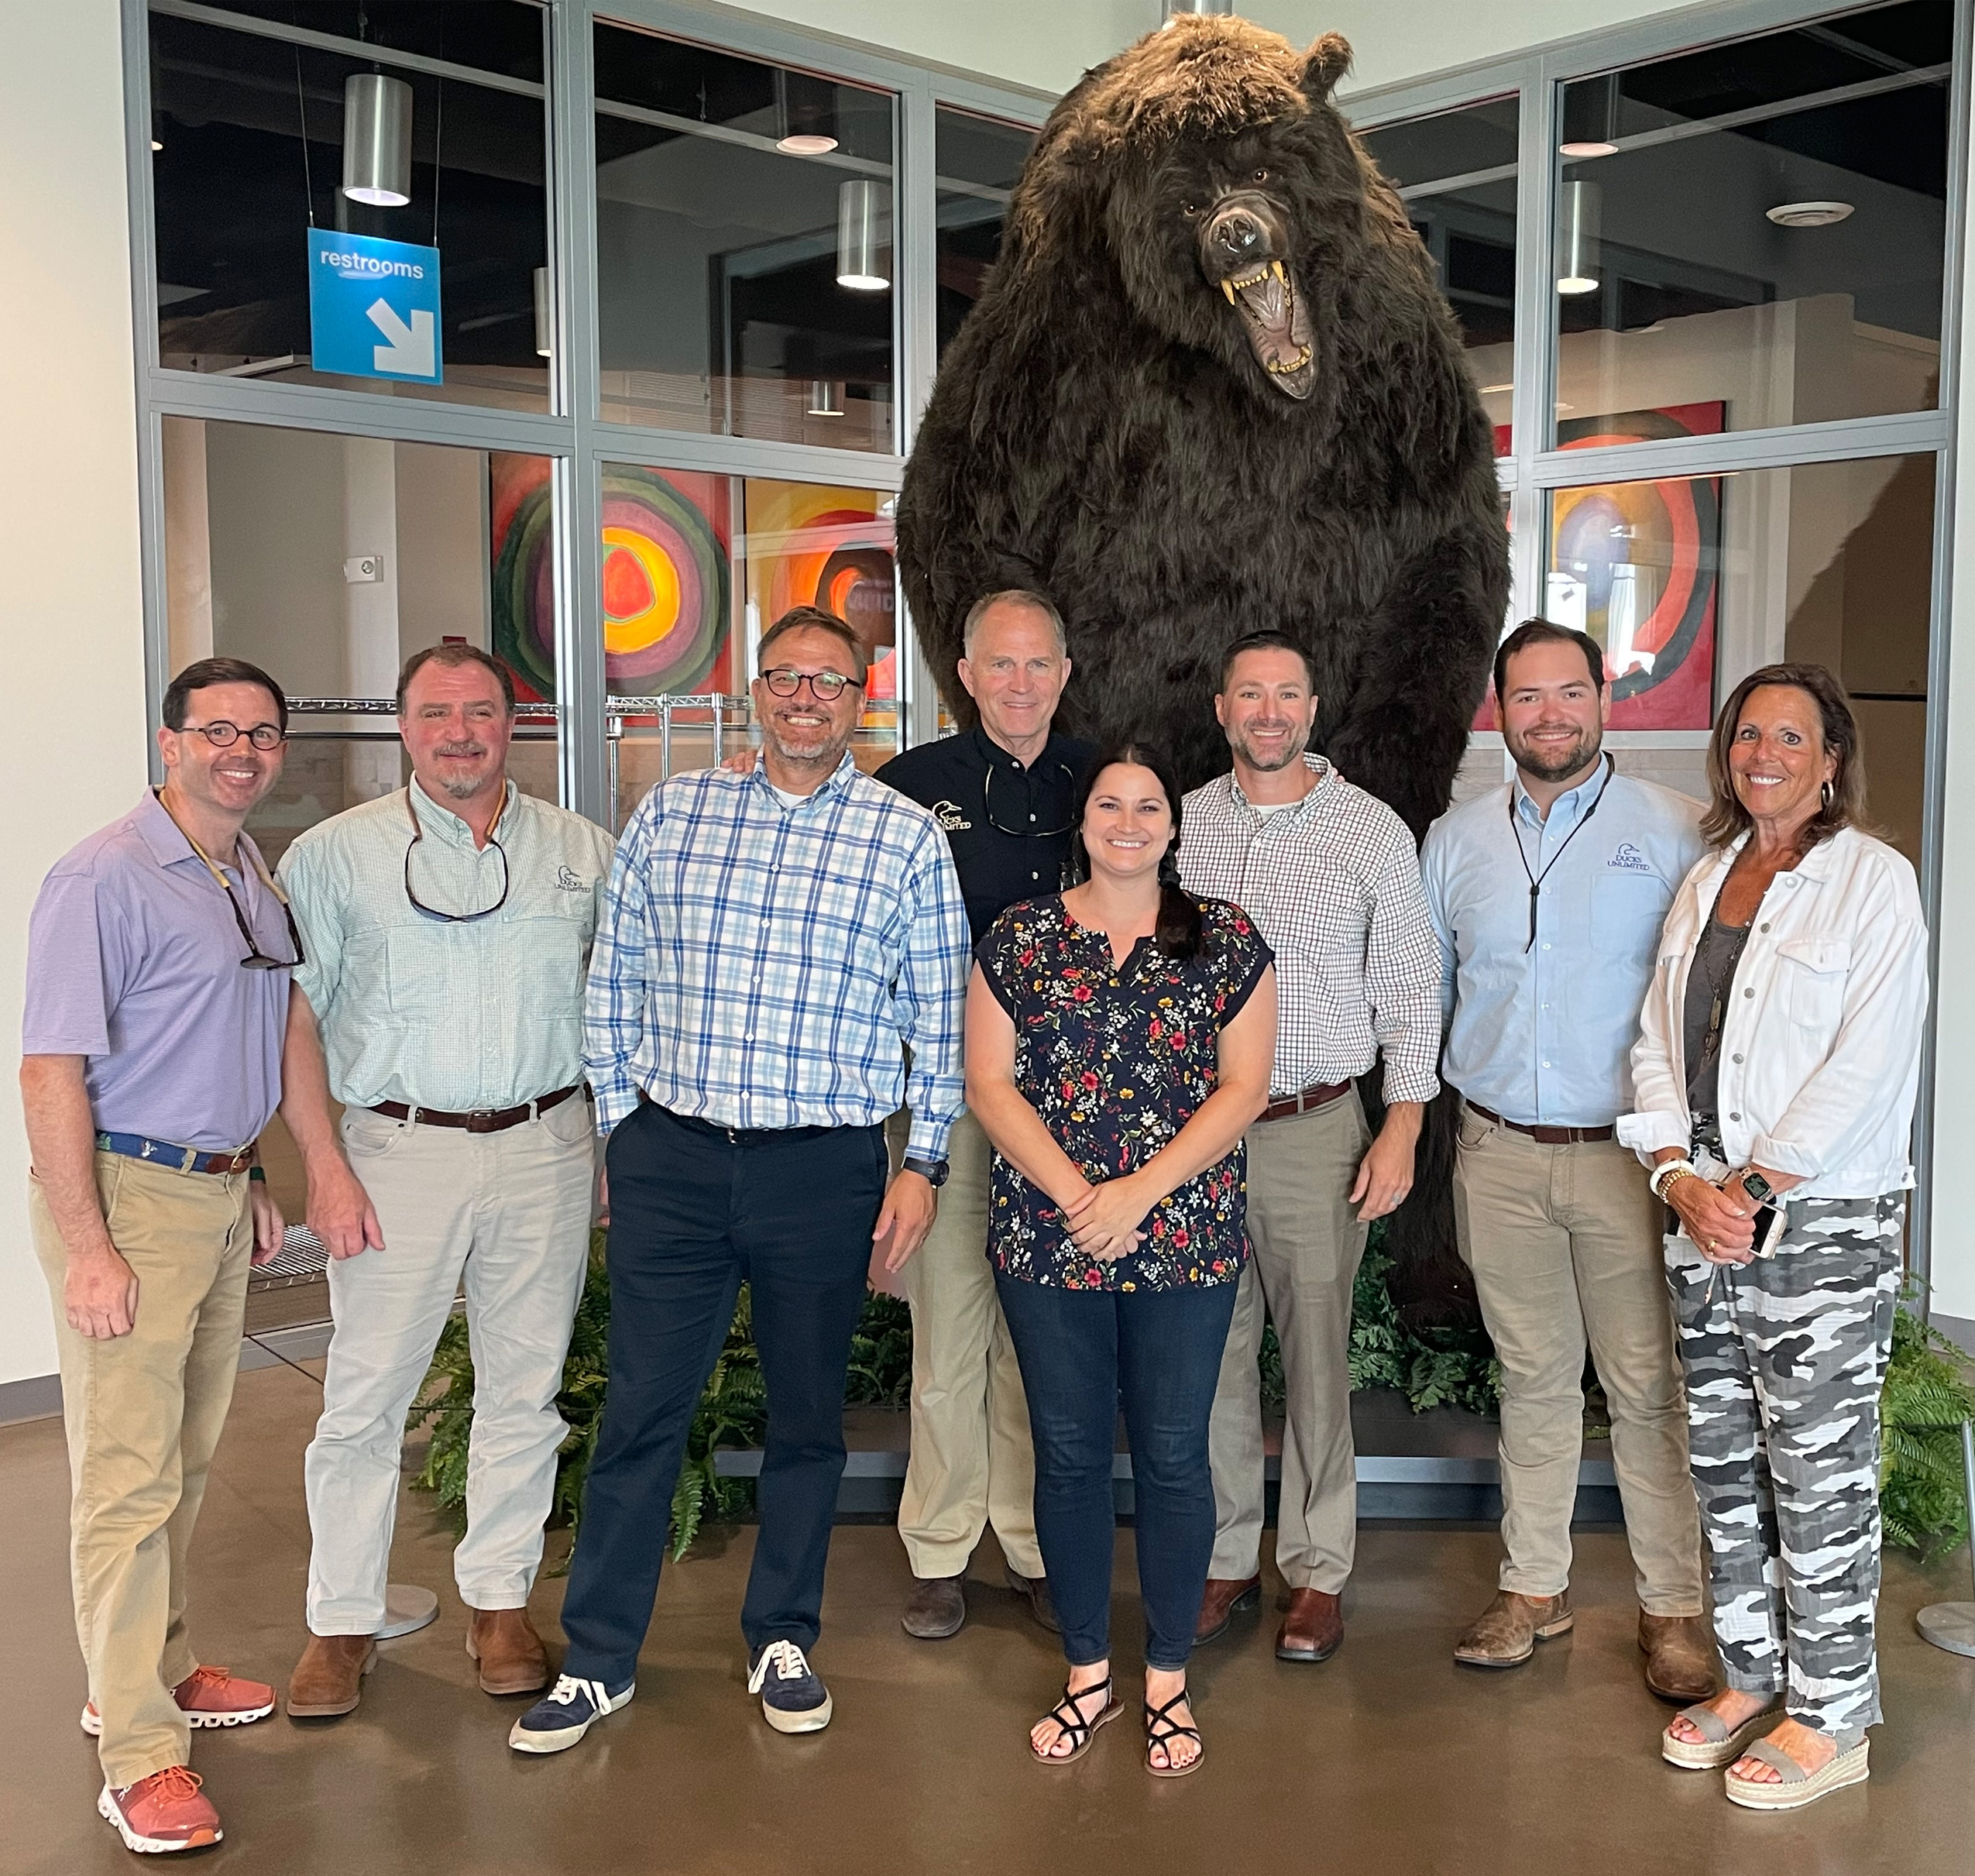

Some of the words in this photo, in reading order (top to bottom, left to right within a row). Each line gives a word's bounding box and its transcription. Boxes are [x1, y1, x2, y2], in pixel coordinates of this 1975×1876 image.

[321, 250, 424, 279] restrooms
[1616, 854, 1642, 864] DUCKS
[1607, 861, 1650, 871] UNLIMITED
